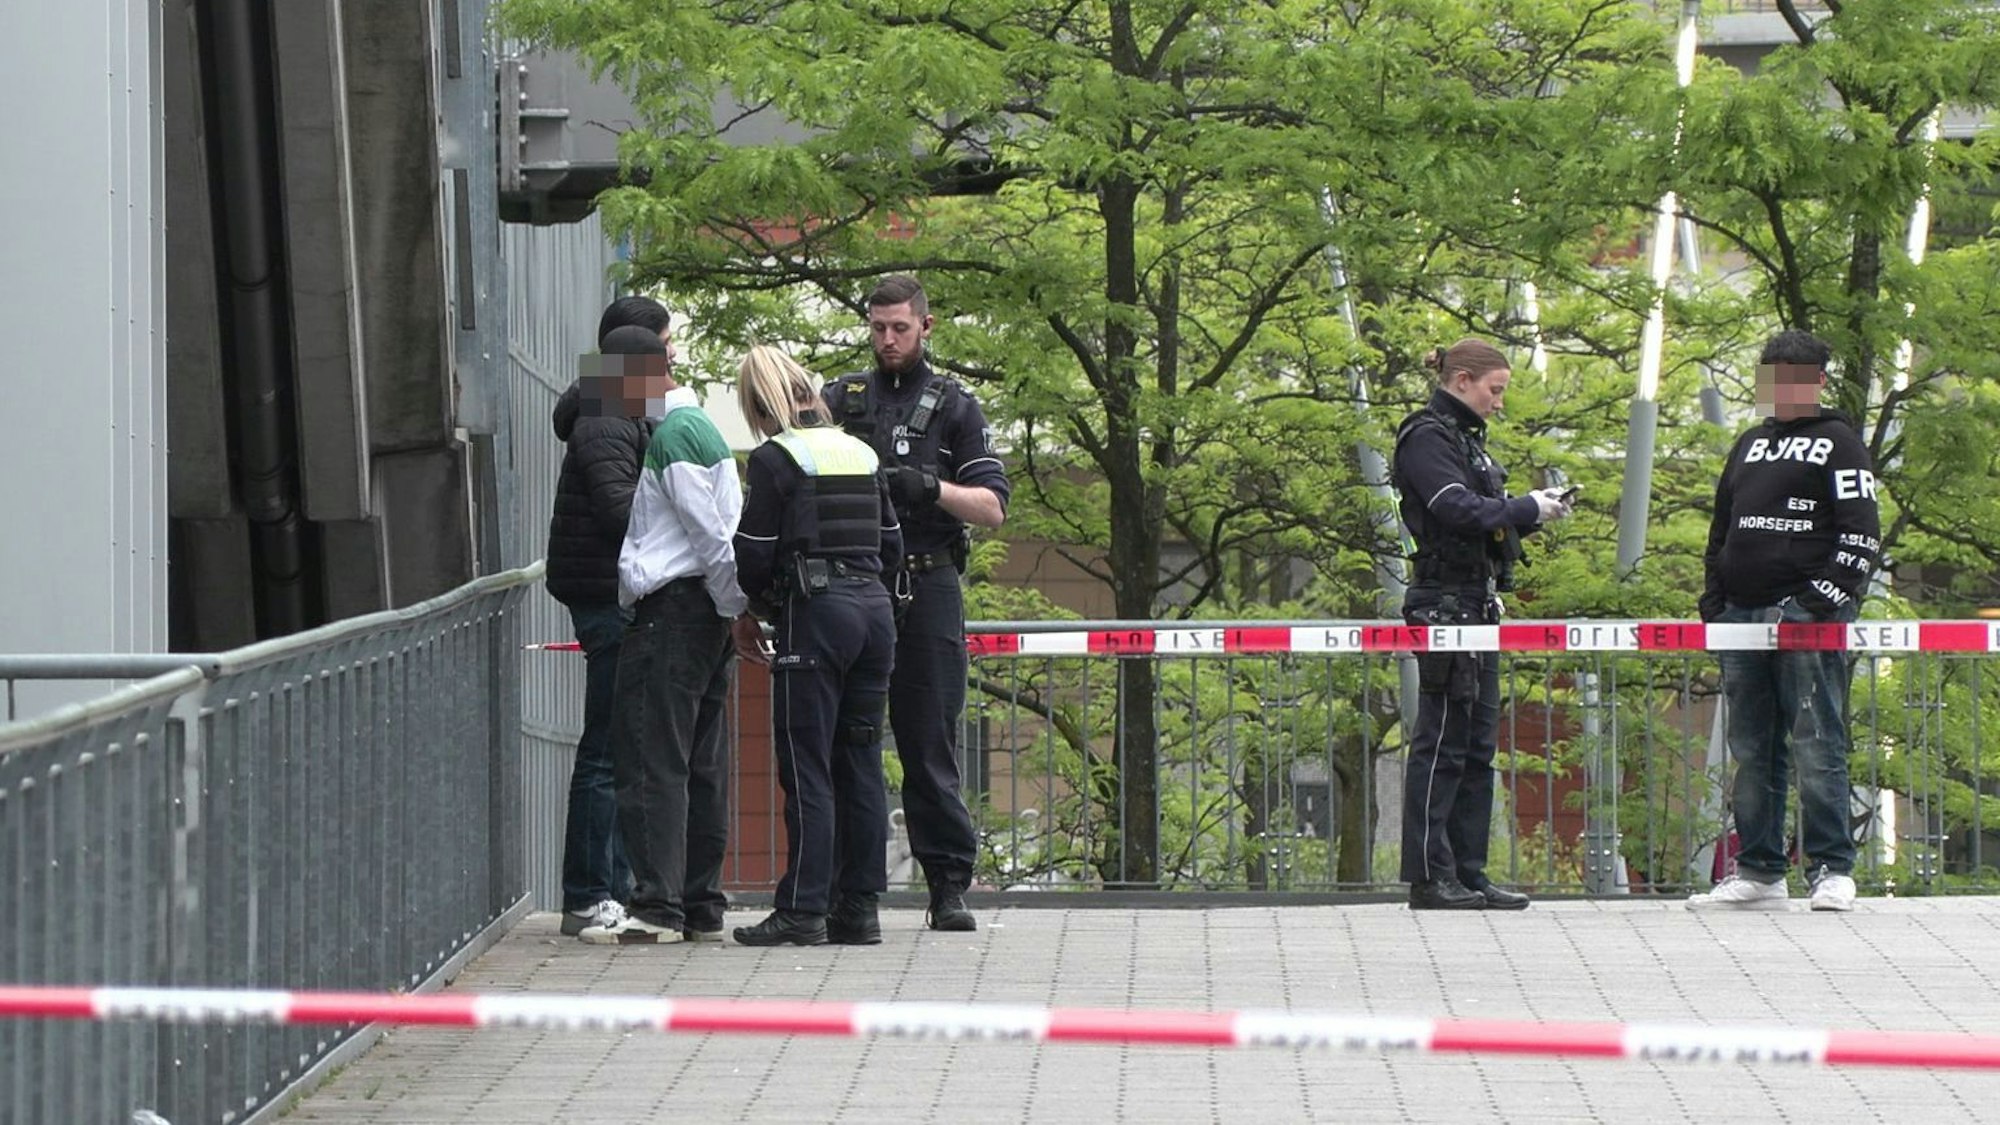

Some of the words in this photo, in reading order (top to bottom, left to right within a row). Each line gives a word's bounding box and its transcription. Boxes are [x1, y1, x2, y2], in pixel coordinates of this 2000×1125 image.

[1834, 469, 1877, 501] ER
[1787, 497, 1817, 511] EST
[1738, 516, 1813, 532] HORSEFER
[1836, 551, 1857, 567] RY
